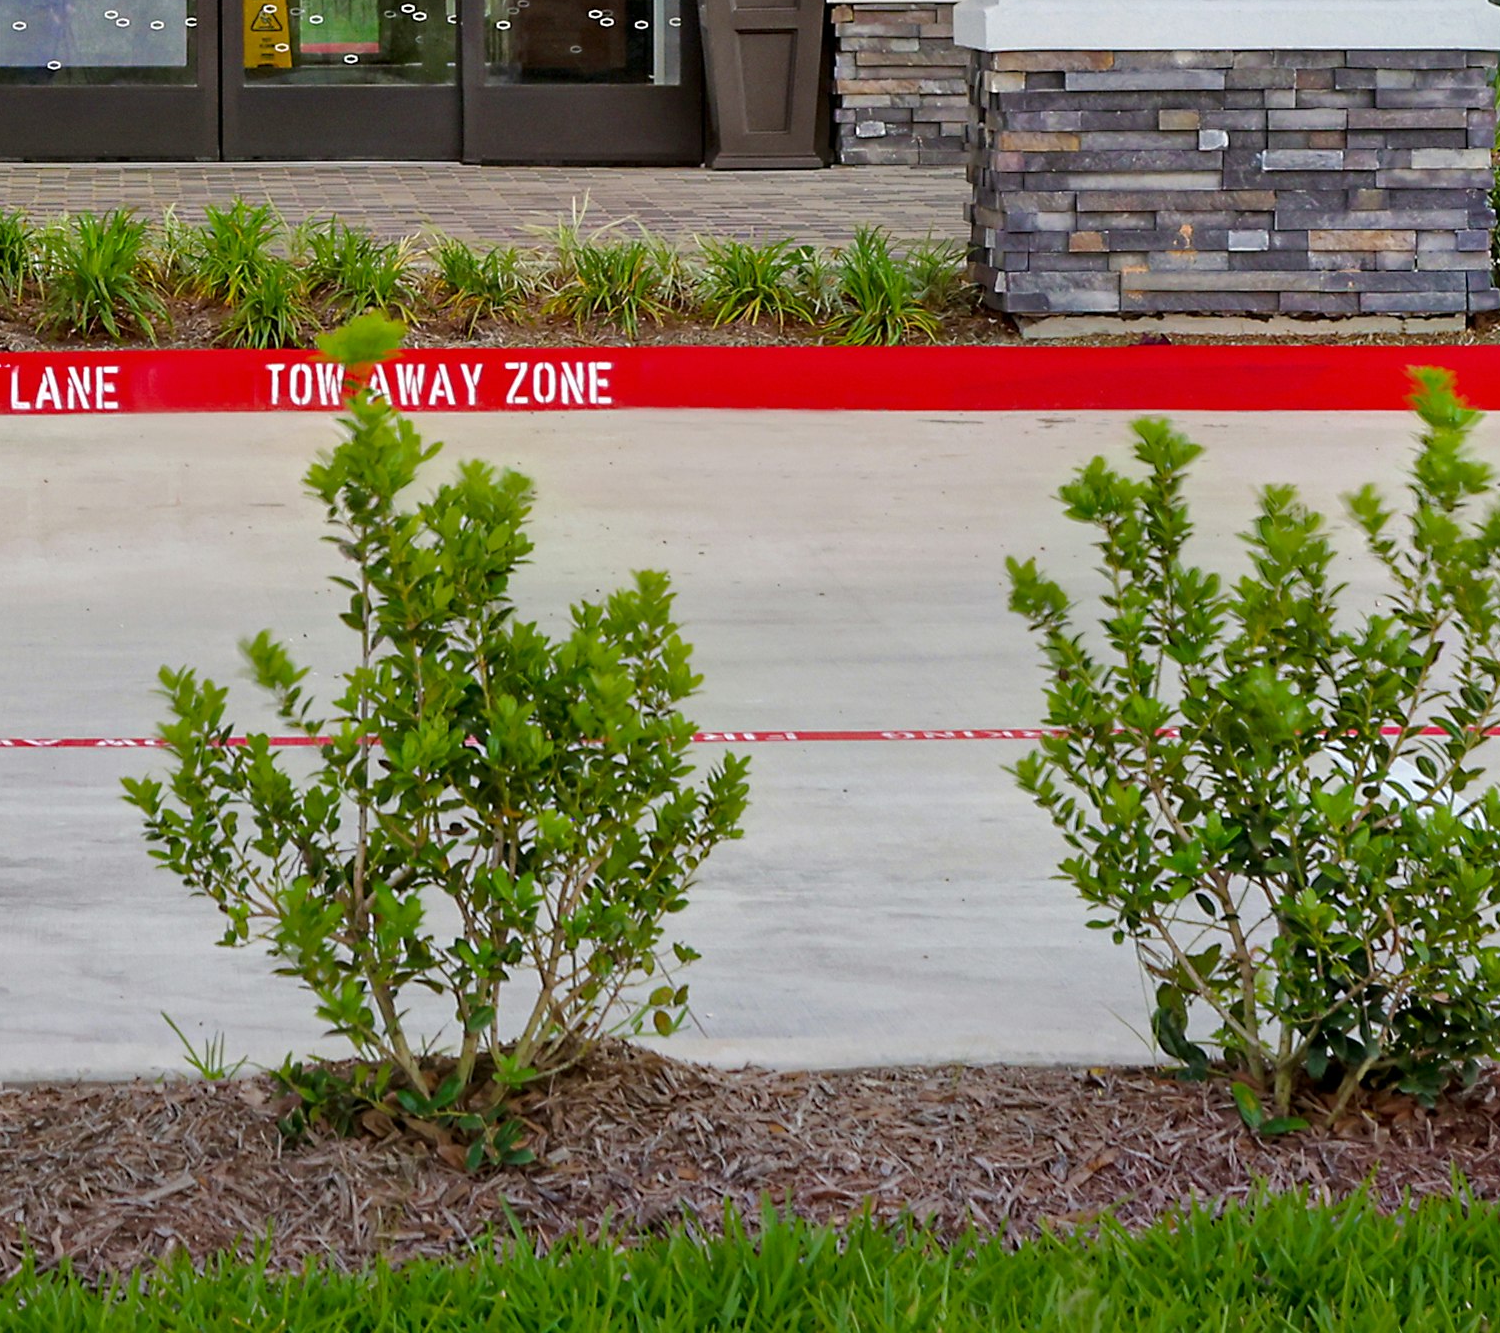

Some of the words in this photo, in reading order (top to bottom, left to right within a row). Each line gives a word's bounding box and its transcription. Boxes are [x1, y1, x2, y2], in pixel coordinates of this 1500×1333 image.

[11, 366, 120, 409] LANE
[266, 363, 345, 405] TOW
[366, 363, 484, 405] AWAY
[504, 361, 614, 404] ZONE
